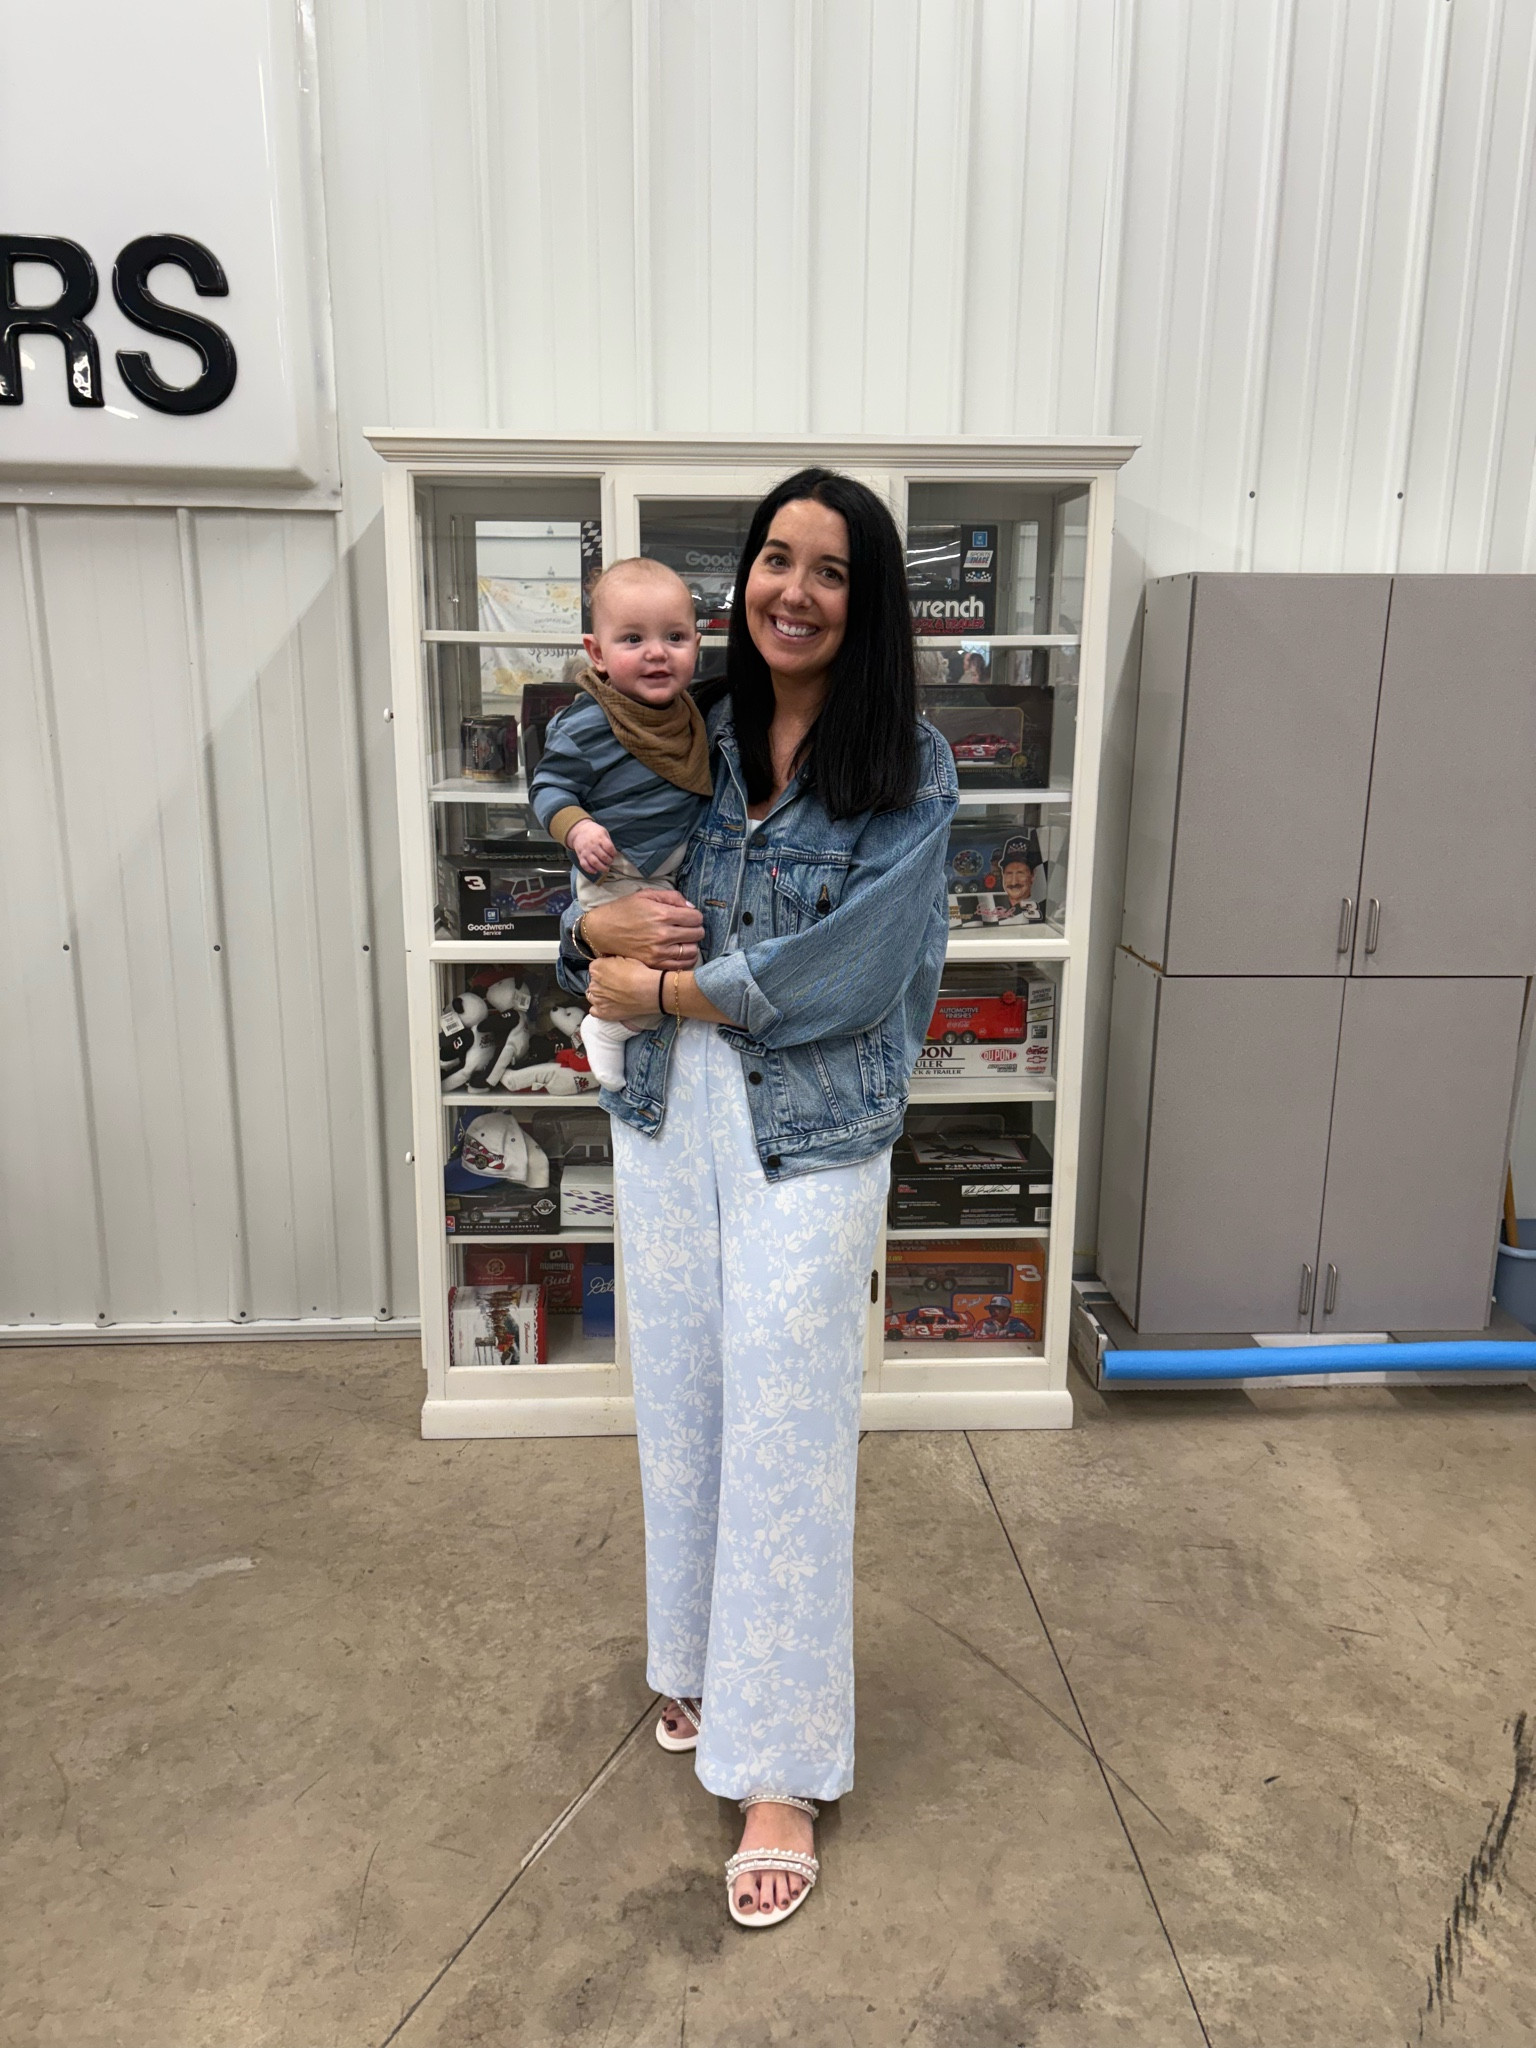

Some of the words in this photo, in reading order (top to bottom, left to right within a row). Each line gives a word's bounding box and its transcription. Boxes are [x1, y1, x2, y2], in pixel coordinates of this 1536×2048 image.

[0, 233, 238, 416] RS
[973, 746, 985, 756] 3
[464, 875, 487, 891] 3
[1021, 901, 1043, 920] 3
[467, 923, 514, 931] Goodwrench
[453, 1036, 463, 1049] 3
[1016, 1264, 1041, 1281] 3
[543, 1275, 571, 1286] Bud
[916, 1325, 930, 1335] 3
